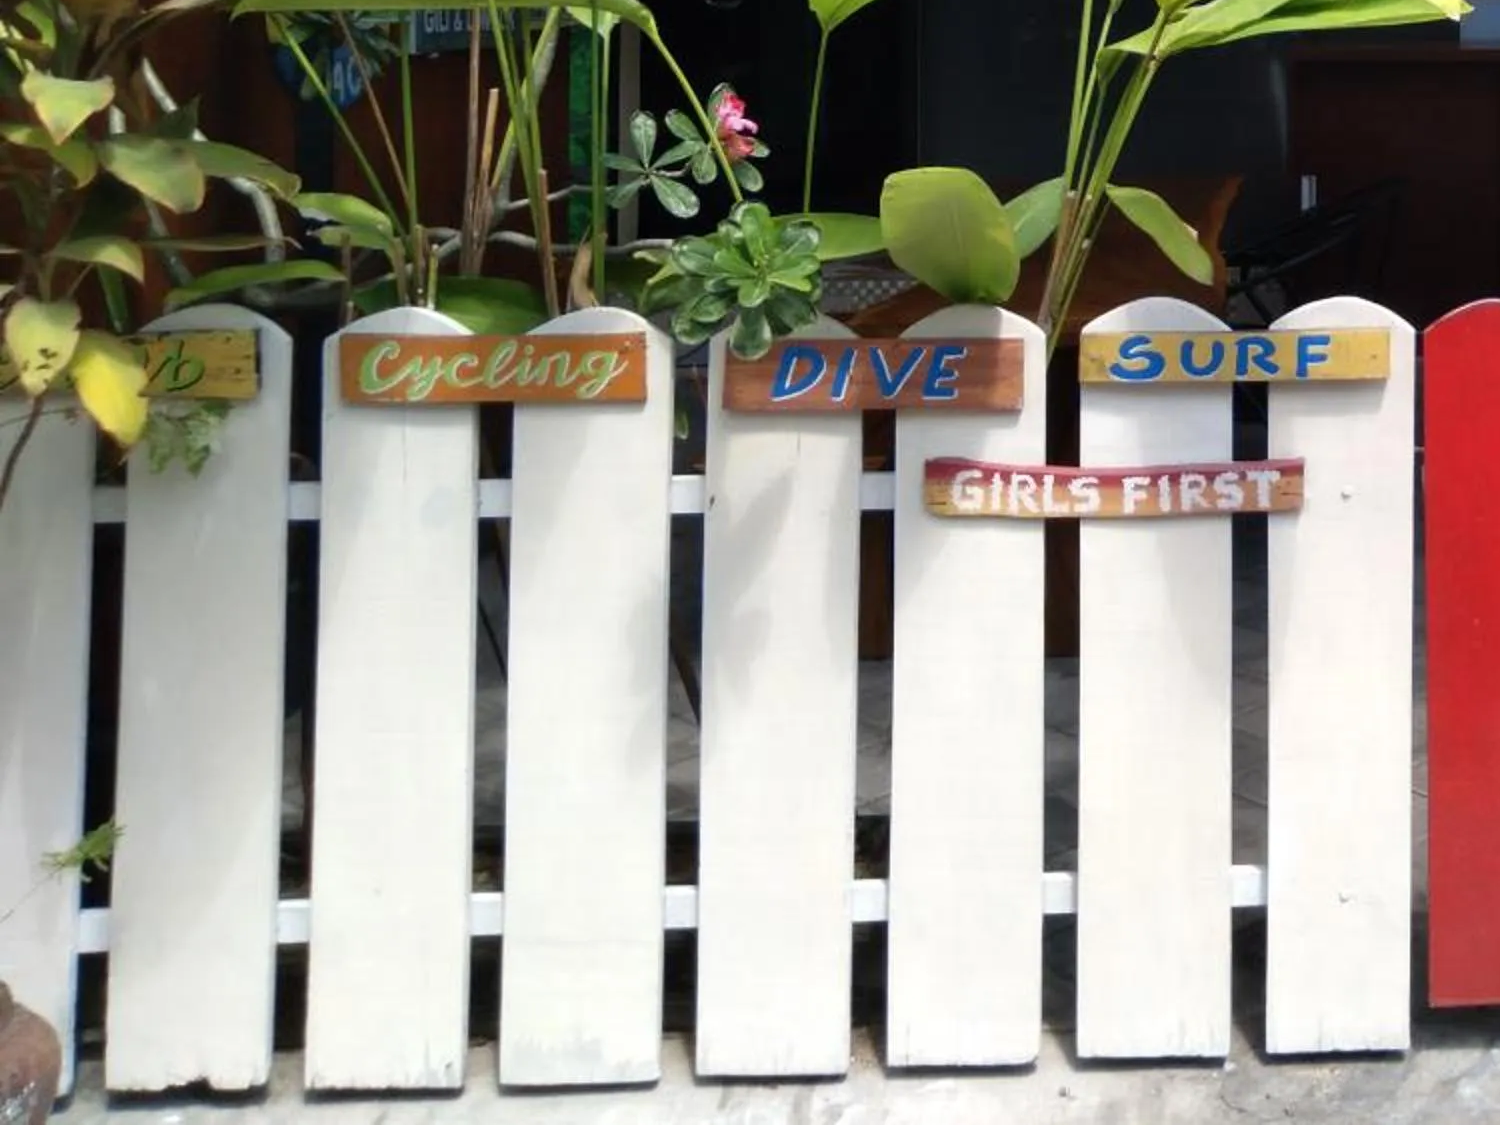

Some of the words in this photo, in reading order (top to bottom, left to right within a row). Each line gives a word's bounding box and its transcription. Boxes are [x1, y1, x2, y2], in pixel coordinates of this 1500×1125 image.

[359, 339, 629, 402] Cycling
[770, 345, 968, 402] DIVE
[1108, 333, 1332, 381] SURF
[951, 469, 1102, 514] GIRLS
[1122, 469, 1282, 514] FIRST
